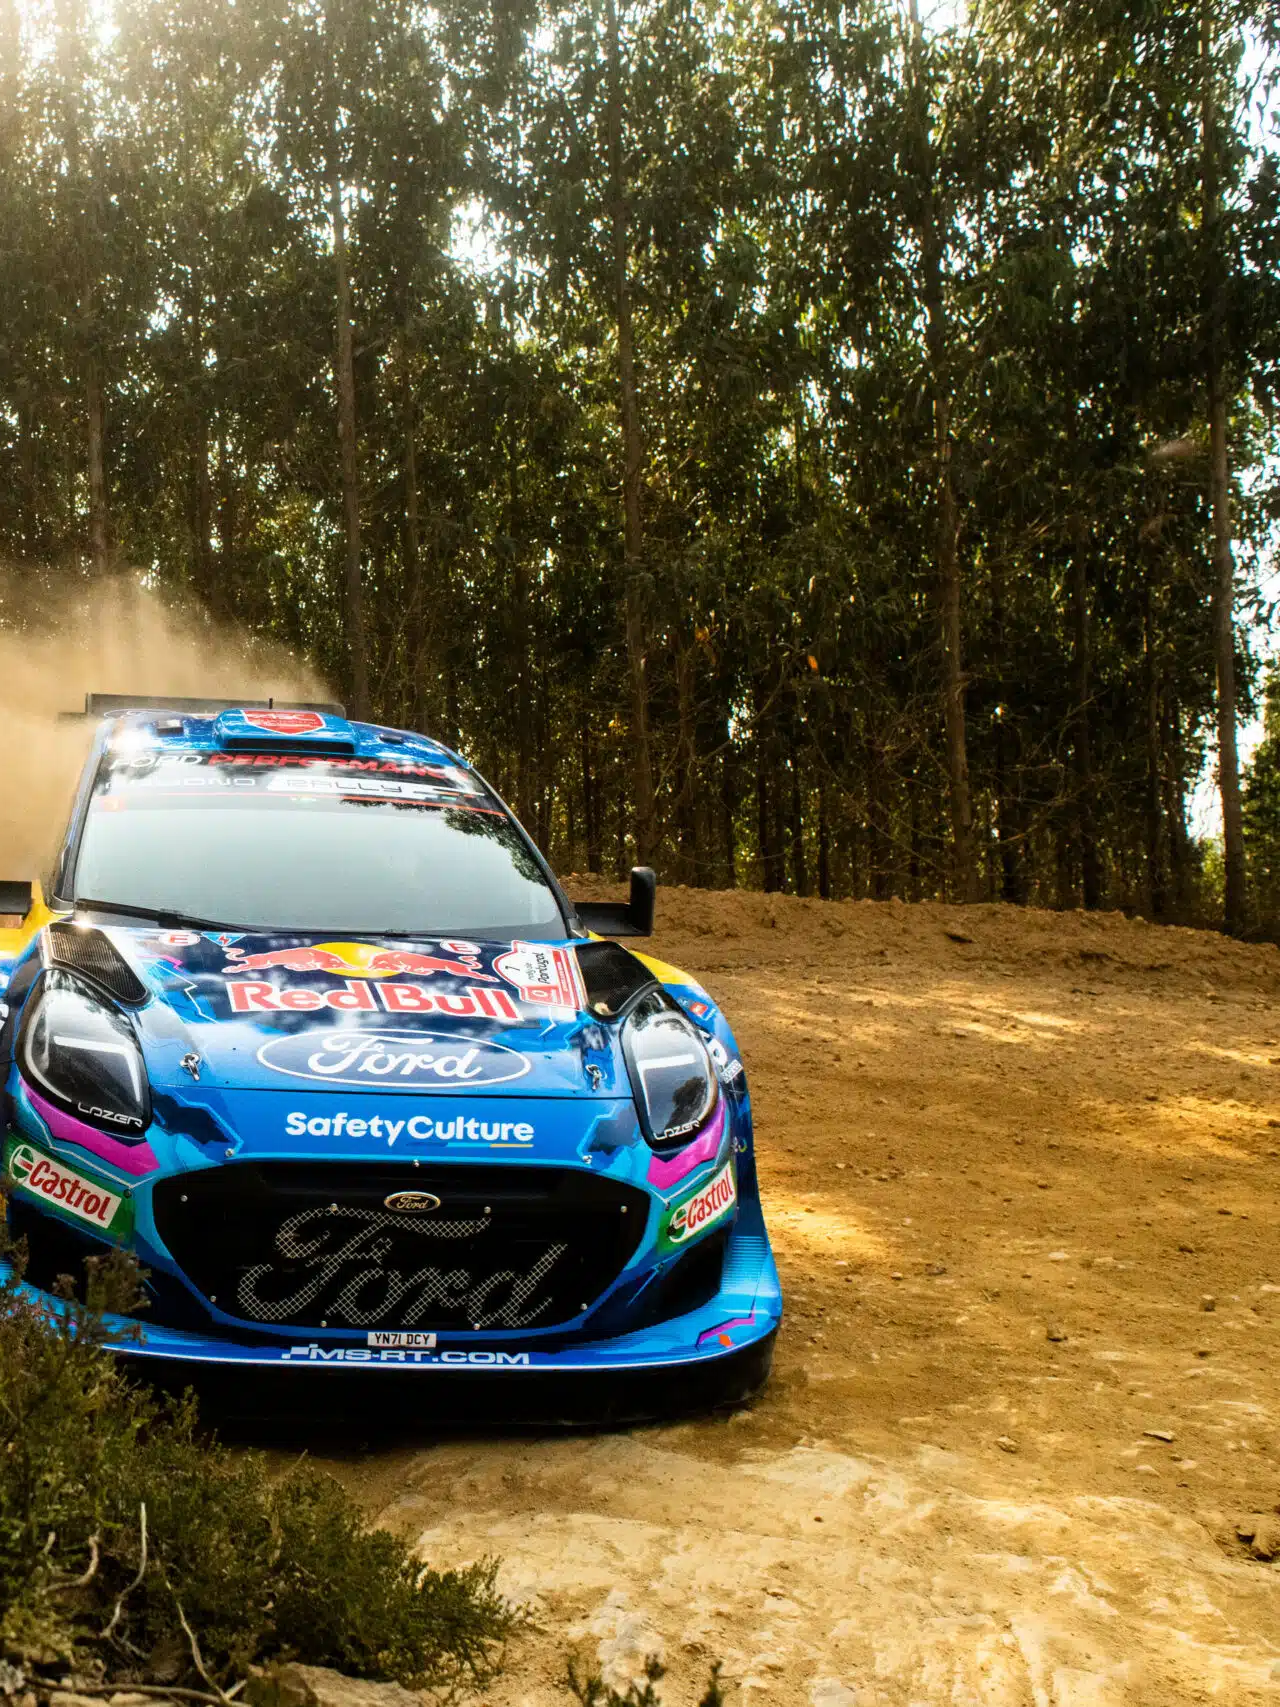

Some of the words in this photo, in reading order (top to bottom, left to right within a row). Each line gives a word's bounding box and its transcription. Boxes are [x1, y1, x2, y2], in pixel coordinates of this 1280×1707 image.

[109, 755, 204, 770] FORD
[532, 952, 551, 985] Portugal
[226, 980, 377, 1012] Red
[373, 982, 523, 1021] Bull
[307, 1032, 482, 1078] Ford
[285, 1111, 534, 1147] SafetyCulture
[28, 1160, 111, 1221] Castrol
[396, 1196, 430, 1209] Ford
[686, 1168, 733, 1229] Castrol
[237, 1206, 568, 1327] Ford
[308, 1347, 531, 1365] MS-RT.COM
[374, 1332, 402, 1345] YN71
[405, 1333, 431, 1346] DCY
